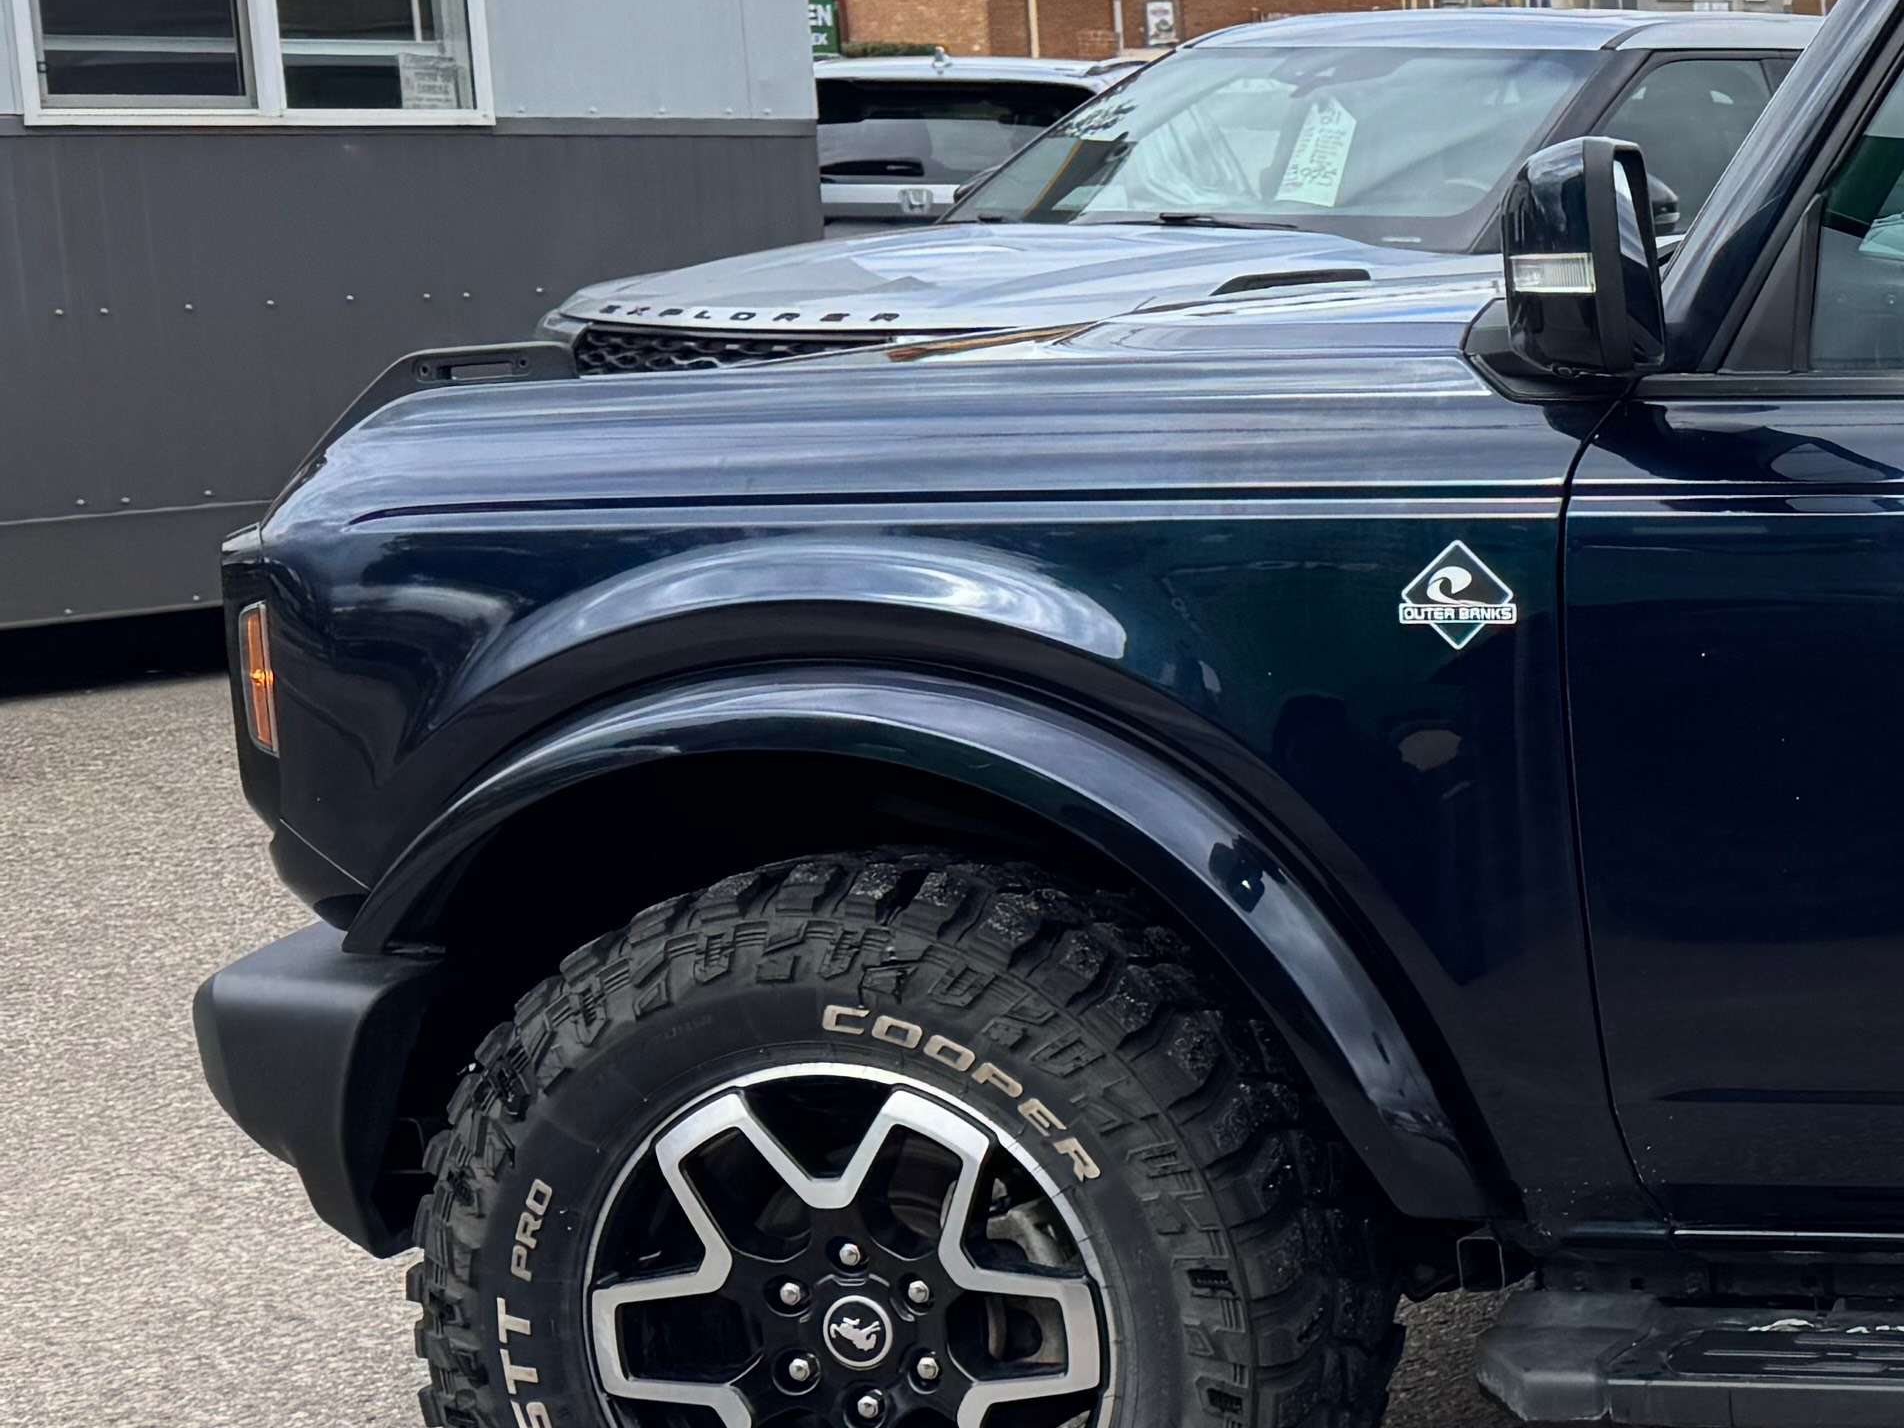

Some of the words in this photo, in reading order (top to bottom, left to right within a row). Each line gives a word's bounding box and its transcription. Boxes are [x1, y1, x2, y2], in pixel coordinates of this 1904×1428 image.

[600, 305, 900, 322] EXPLORER
[1404, 607, 1455, 620] OUTER
[1459, 607, 1512, 620] BANKS
[823, 1004, 1101, 1182] COOPER
[511, 1178, 552, 1281] PRO
